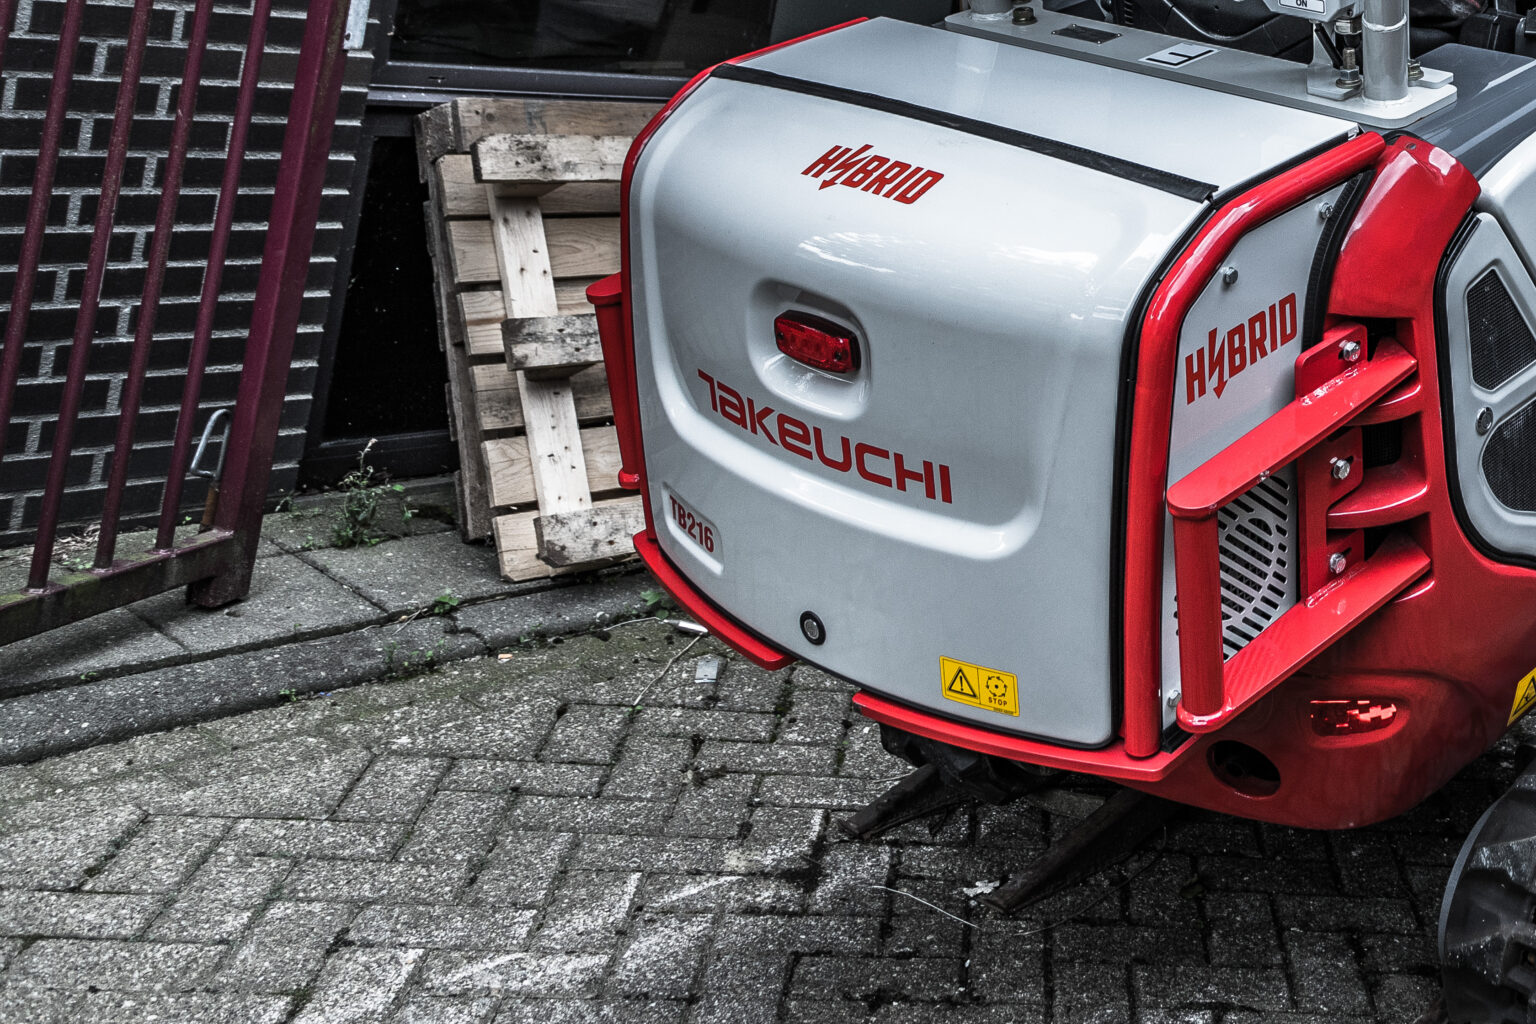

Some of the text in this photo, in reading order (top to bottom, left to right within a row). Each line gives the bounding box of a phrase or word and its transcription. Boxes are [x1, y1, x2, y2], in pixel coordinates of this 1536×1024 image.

[801, 144, 945, 205] HYBRID
[1185, 292, 1298, 406] HYBRID
[669, 494, 715, 553] TB216
[988, 696, 1008, 707] STOP
